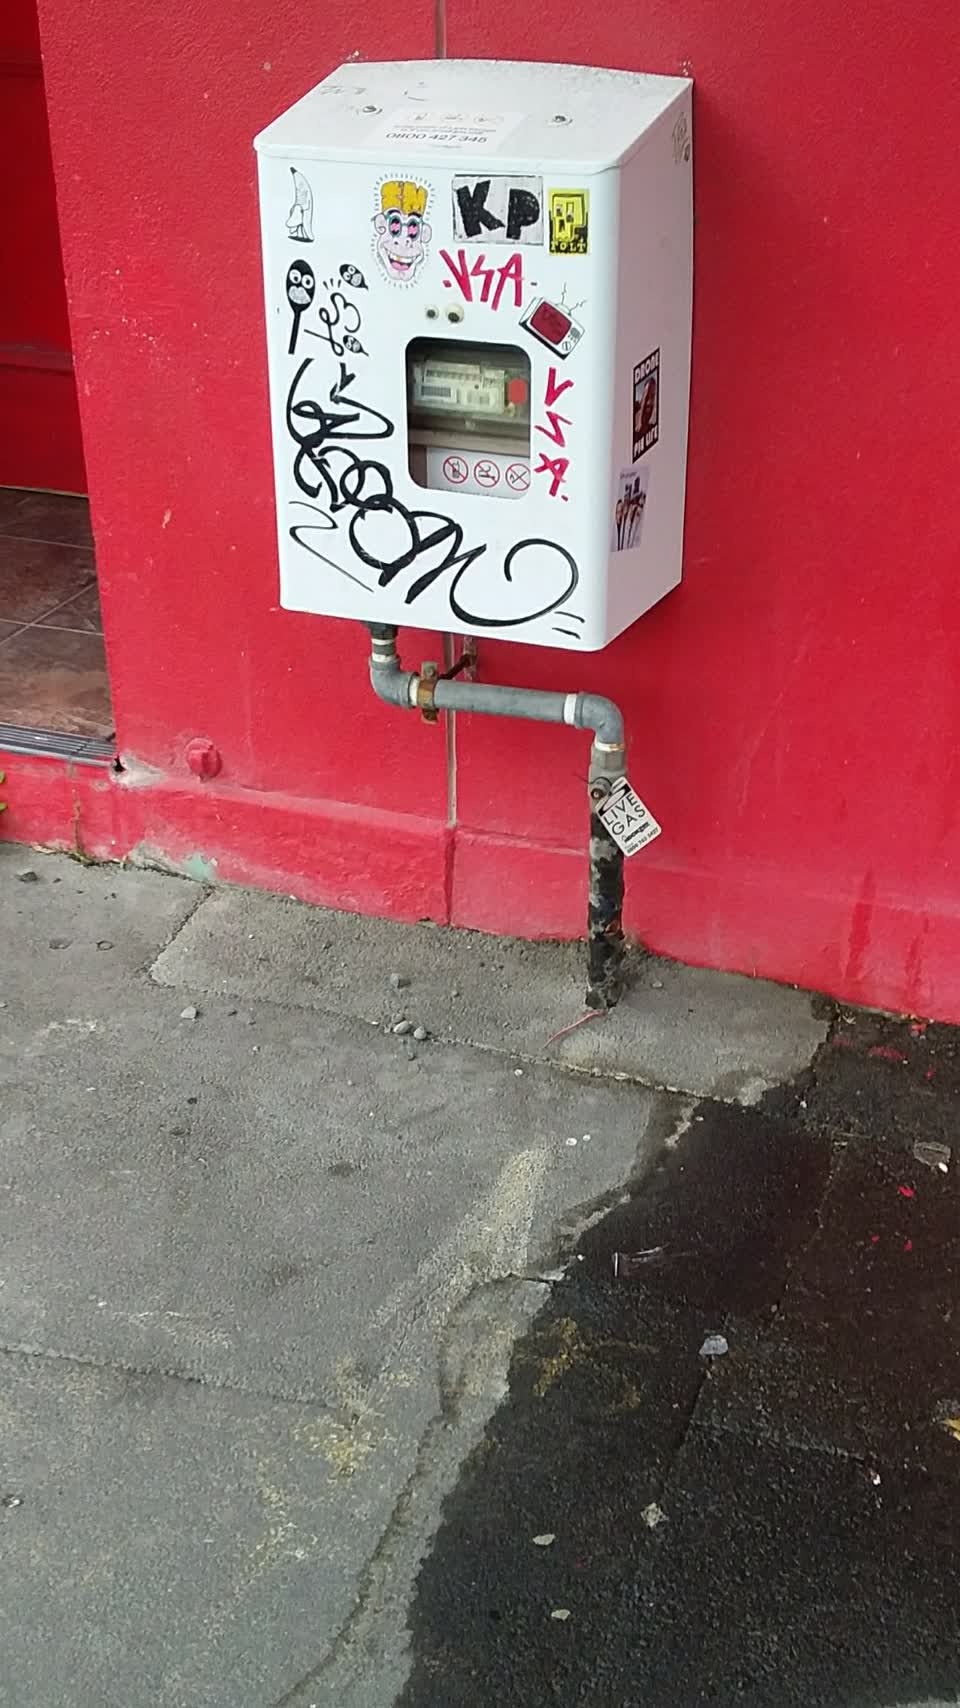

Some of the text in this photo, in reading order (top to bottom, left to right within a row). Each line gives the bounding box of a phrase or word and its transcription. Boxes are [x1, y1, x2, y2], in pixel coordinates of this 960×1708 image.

[386, 132, 427, 140] 0800
[455, 179, 541, 240] KP
[604, 793, 637, 826] LIVE
[612, 805, 645, 835] GAS
